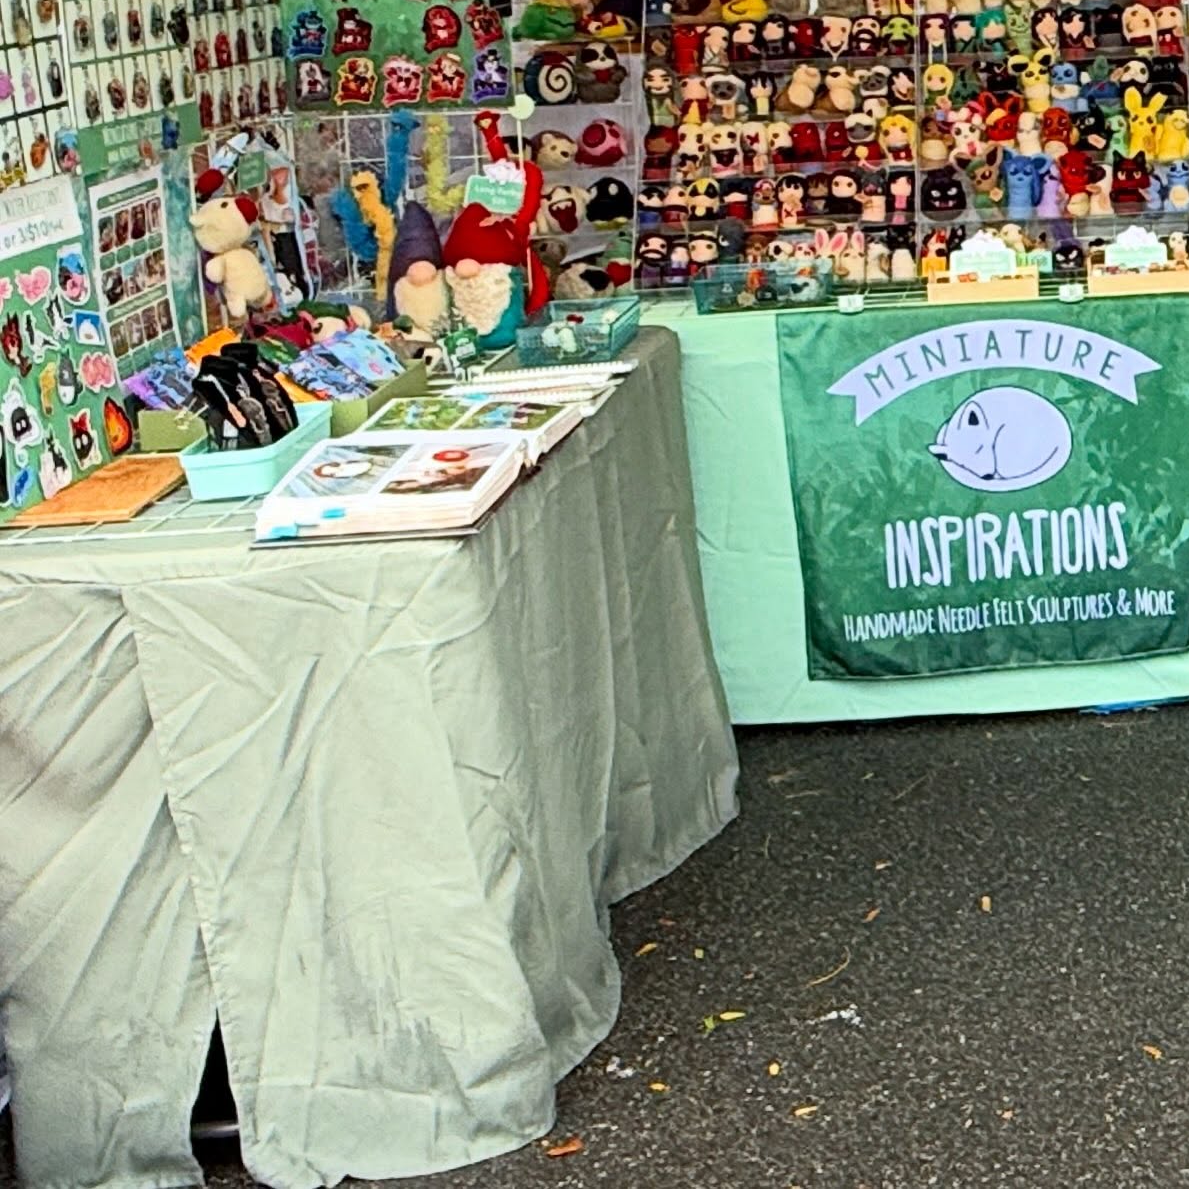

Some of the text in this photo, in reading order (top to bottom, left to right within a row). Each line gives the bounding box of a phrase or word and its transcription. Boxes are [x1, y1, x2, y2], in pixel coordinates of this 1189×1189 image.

[864, 329, 1123, 397] MINIATURE
[885, 503, 1128, 589] INSPIRATIONS
[843, 587, 1176, 642] HANDMADE NEEDLE FELT SCULPTURES & MORE
